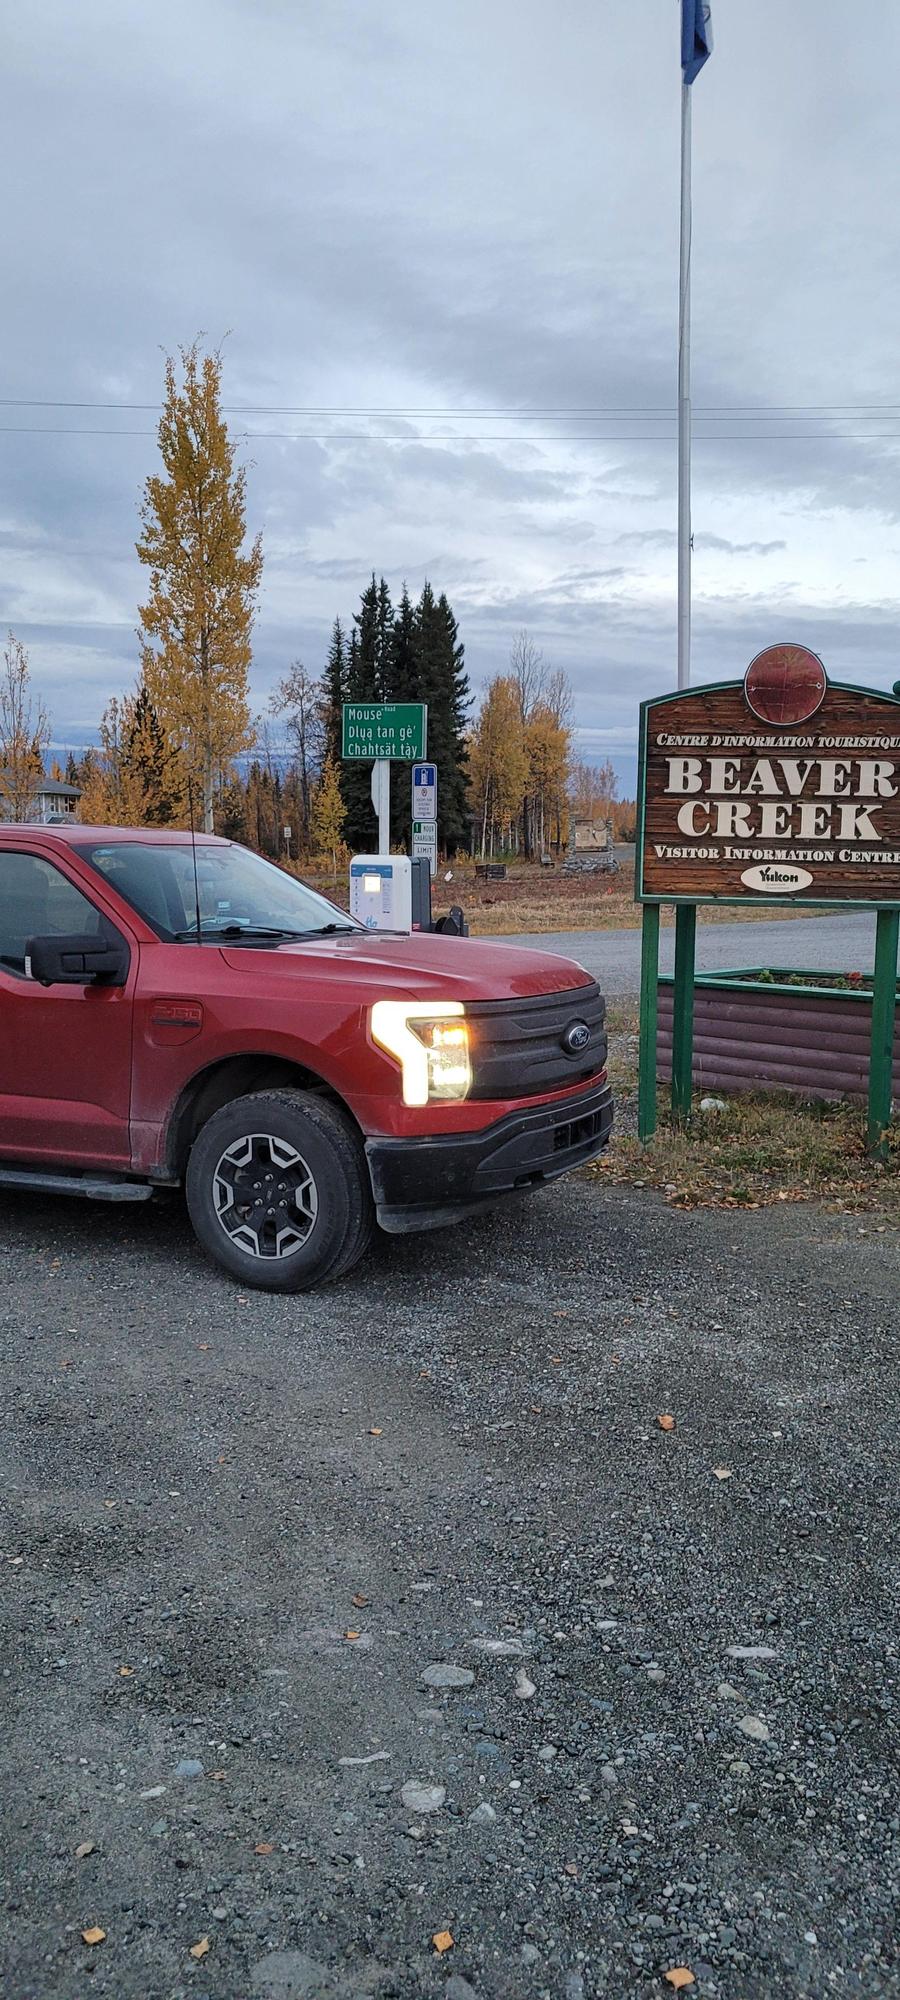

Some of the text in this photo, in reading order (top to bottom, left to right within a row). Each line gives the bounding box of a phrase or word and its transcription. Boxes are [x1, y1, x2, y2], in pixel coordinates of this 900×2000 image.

[348, 708, 382, 721] Mouse
[377, 726, 395, 738] tan
[656, 733, 900, 750] CENTRE D'INFORMATION TOURISTIQU
[664, 758, 899, 797] BEAVER
[677, 801, 883, 841] CREEK
[654, 845, 720, 859] VISITOR
[723, 846, 836, 862] INFORMATION
[758, 866, 799, 883] Yukon
